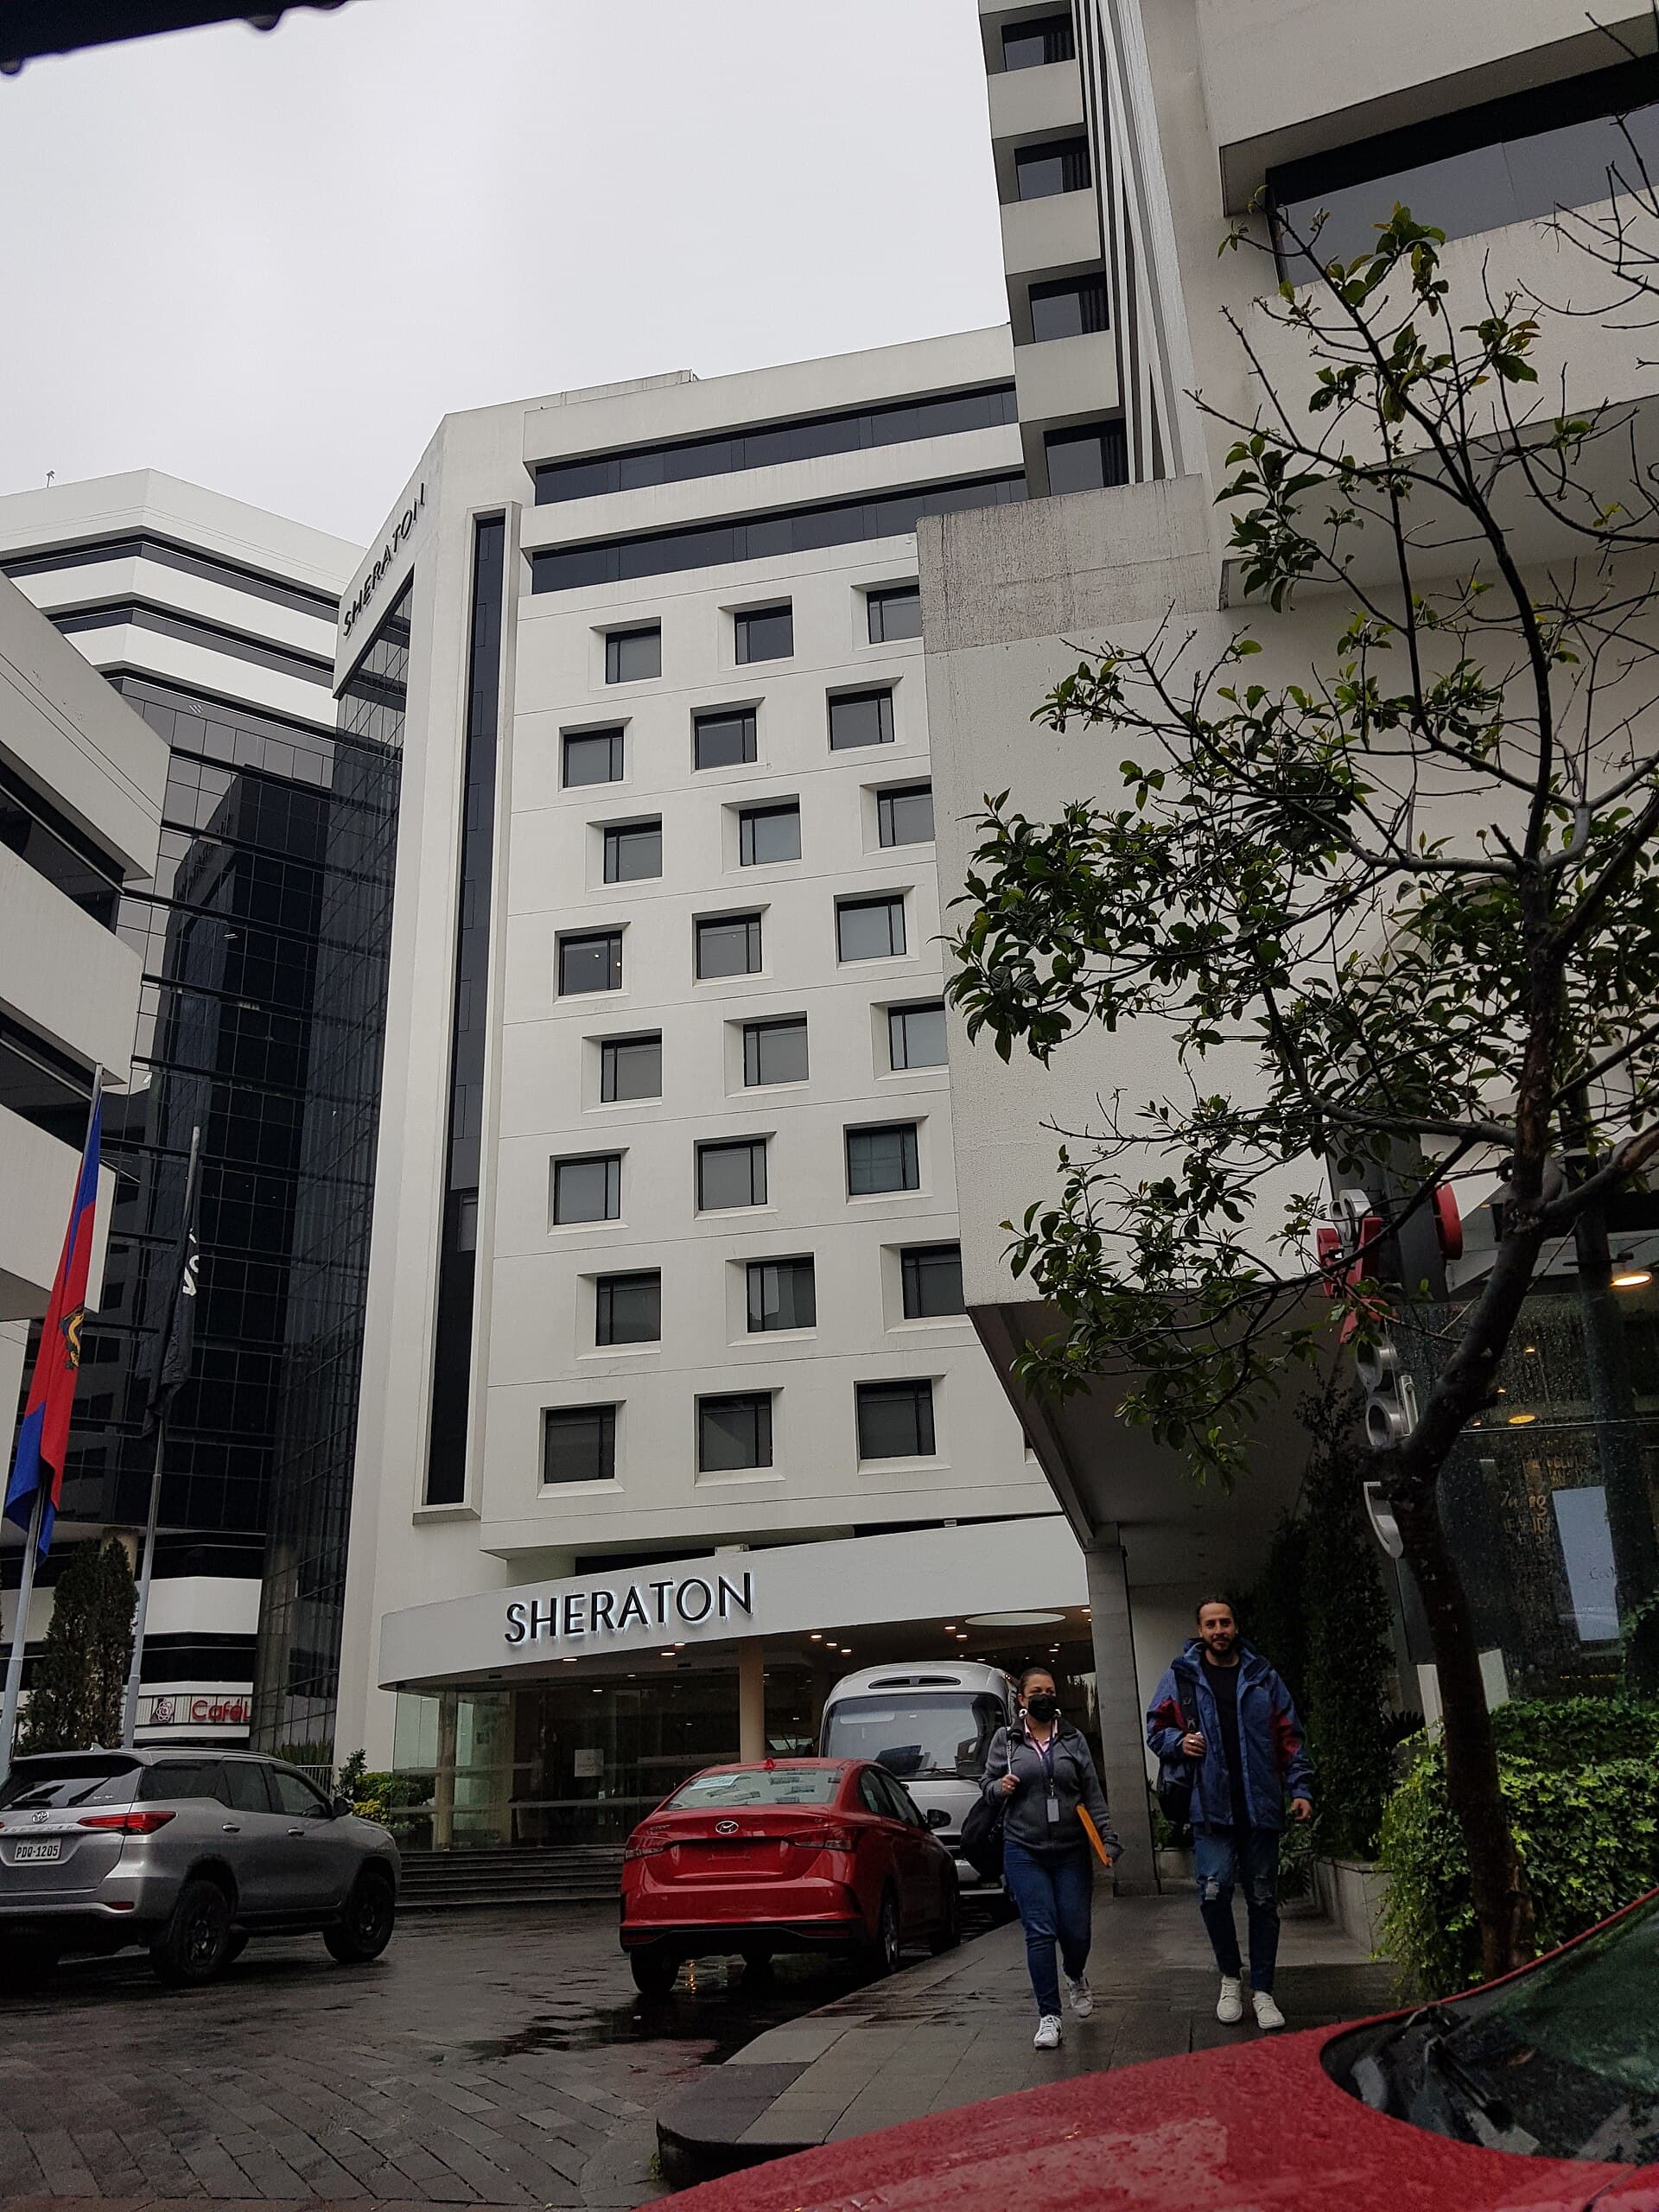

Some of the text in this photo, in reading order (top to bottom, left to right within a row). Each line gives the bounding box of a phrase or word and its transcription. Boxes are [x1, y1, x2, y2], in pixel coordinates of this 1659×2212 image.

[343, 482, 425, 637] SHERATON
[504, 1572, 753, 1643] SHERATON
[16, 1845, 59, 1859] PDQ-1205
